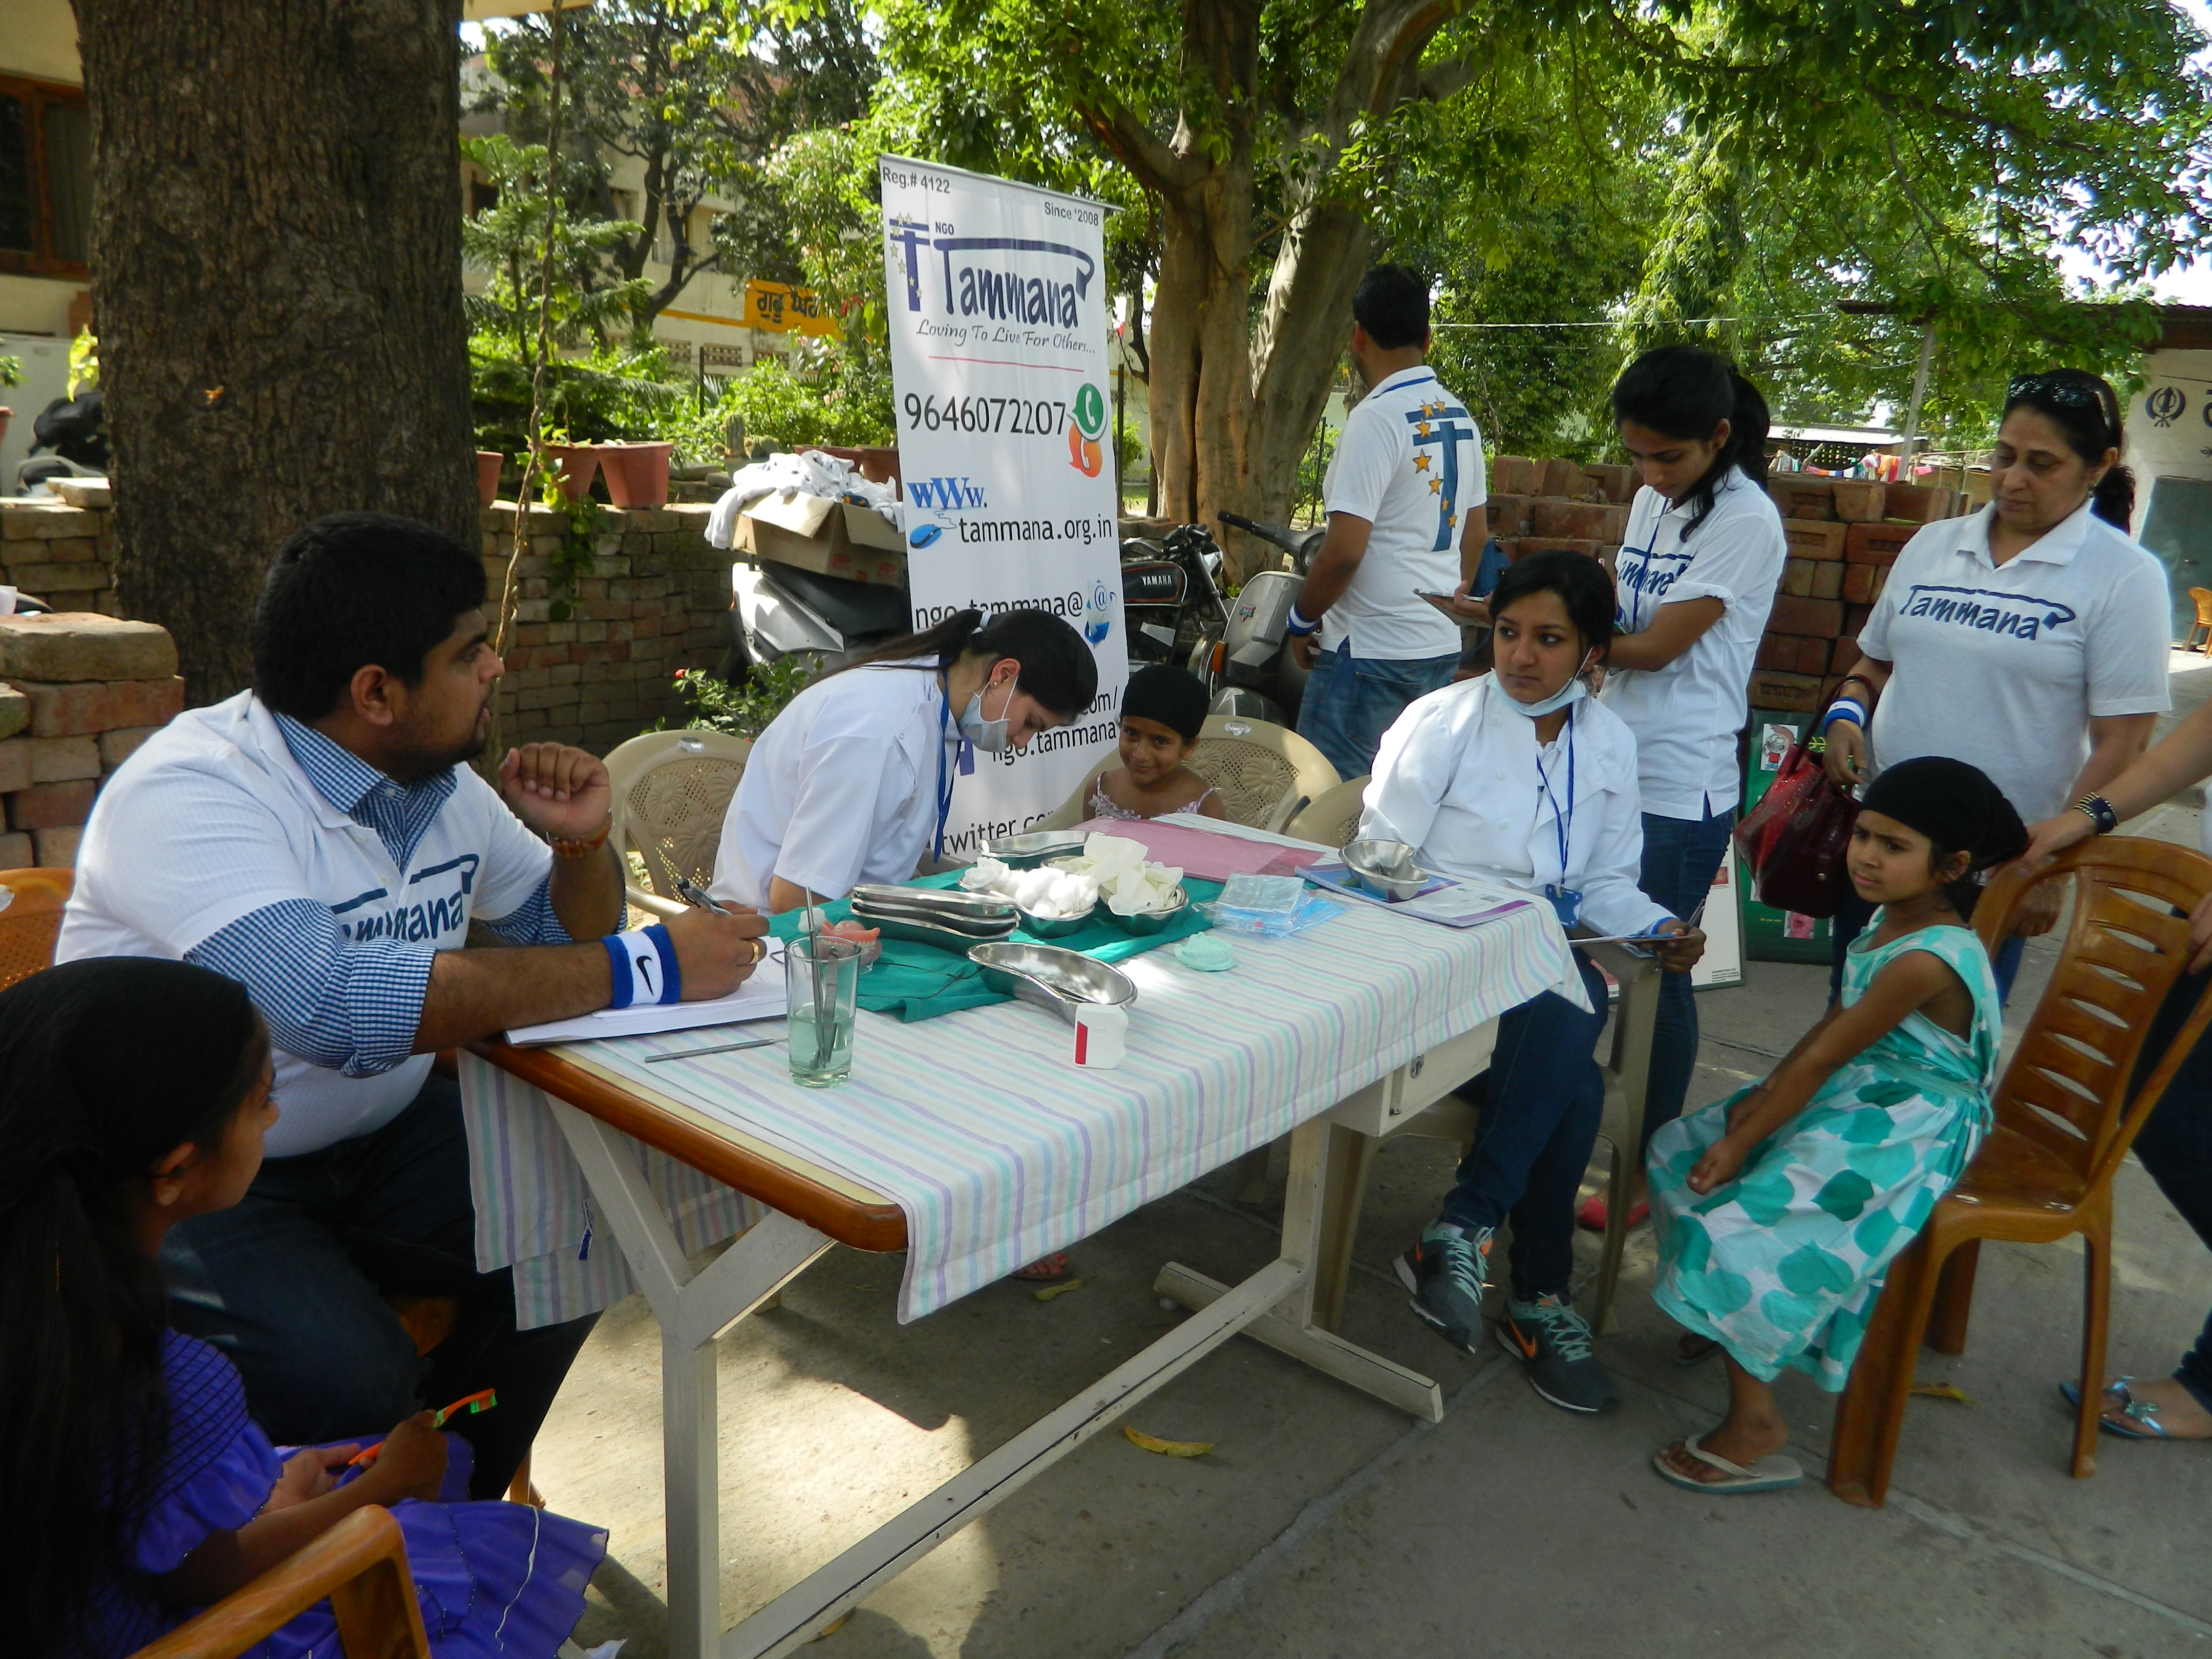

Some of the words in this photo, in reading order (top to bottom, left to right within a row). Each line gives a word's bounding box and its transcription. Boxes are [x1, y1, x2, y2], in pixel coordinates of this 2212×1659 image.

[882, 166, 917, 189] Reg.#
[921, 175, 950, 194] 4122
[1045, 201, 1072, 219] Since
[935, 221, 954, 235] NGO
[933, 238, 1095, 329] Tammana
[917, 318, 967, 347] Loving
[972, 325, 988, 341] To
[992, 327, 1020, 343] Live
[1023, 331, 1050, 347] For
[904, 392, 1066, 435] 9646072207
[959, 513, 1112, 545] tammana.org.in
[1142, 575, 1172, 586] YAMAHA
[1899, 585, 2075, 641] Tammana
